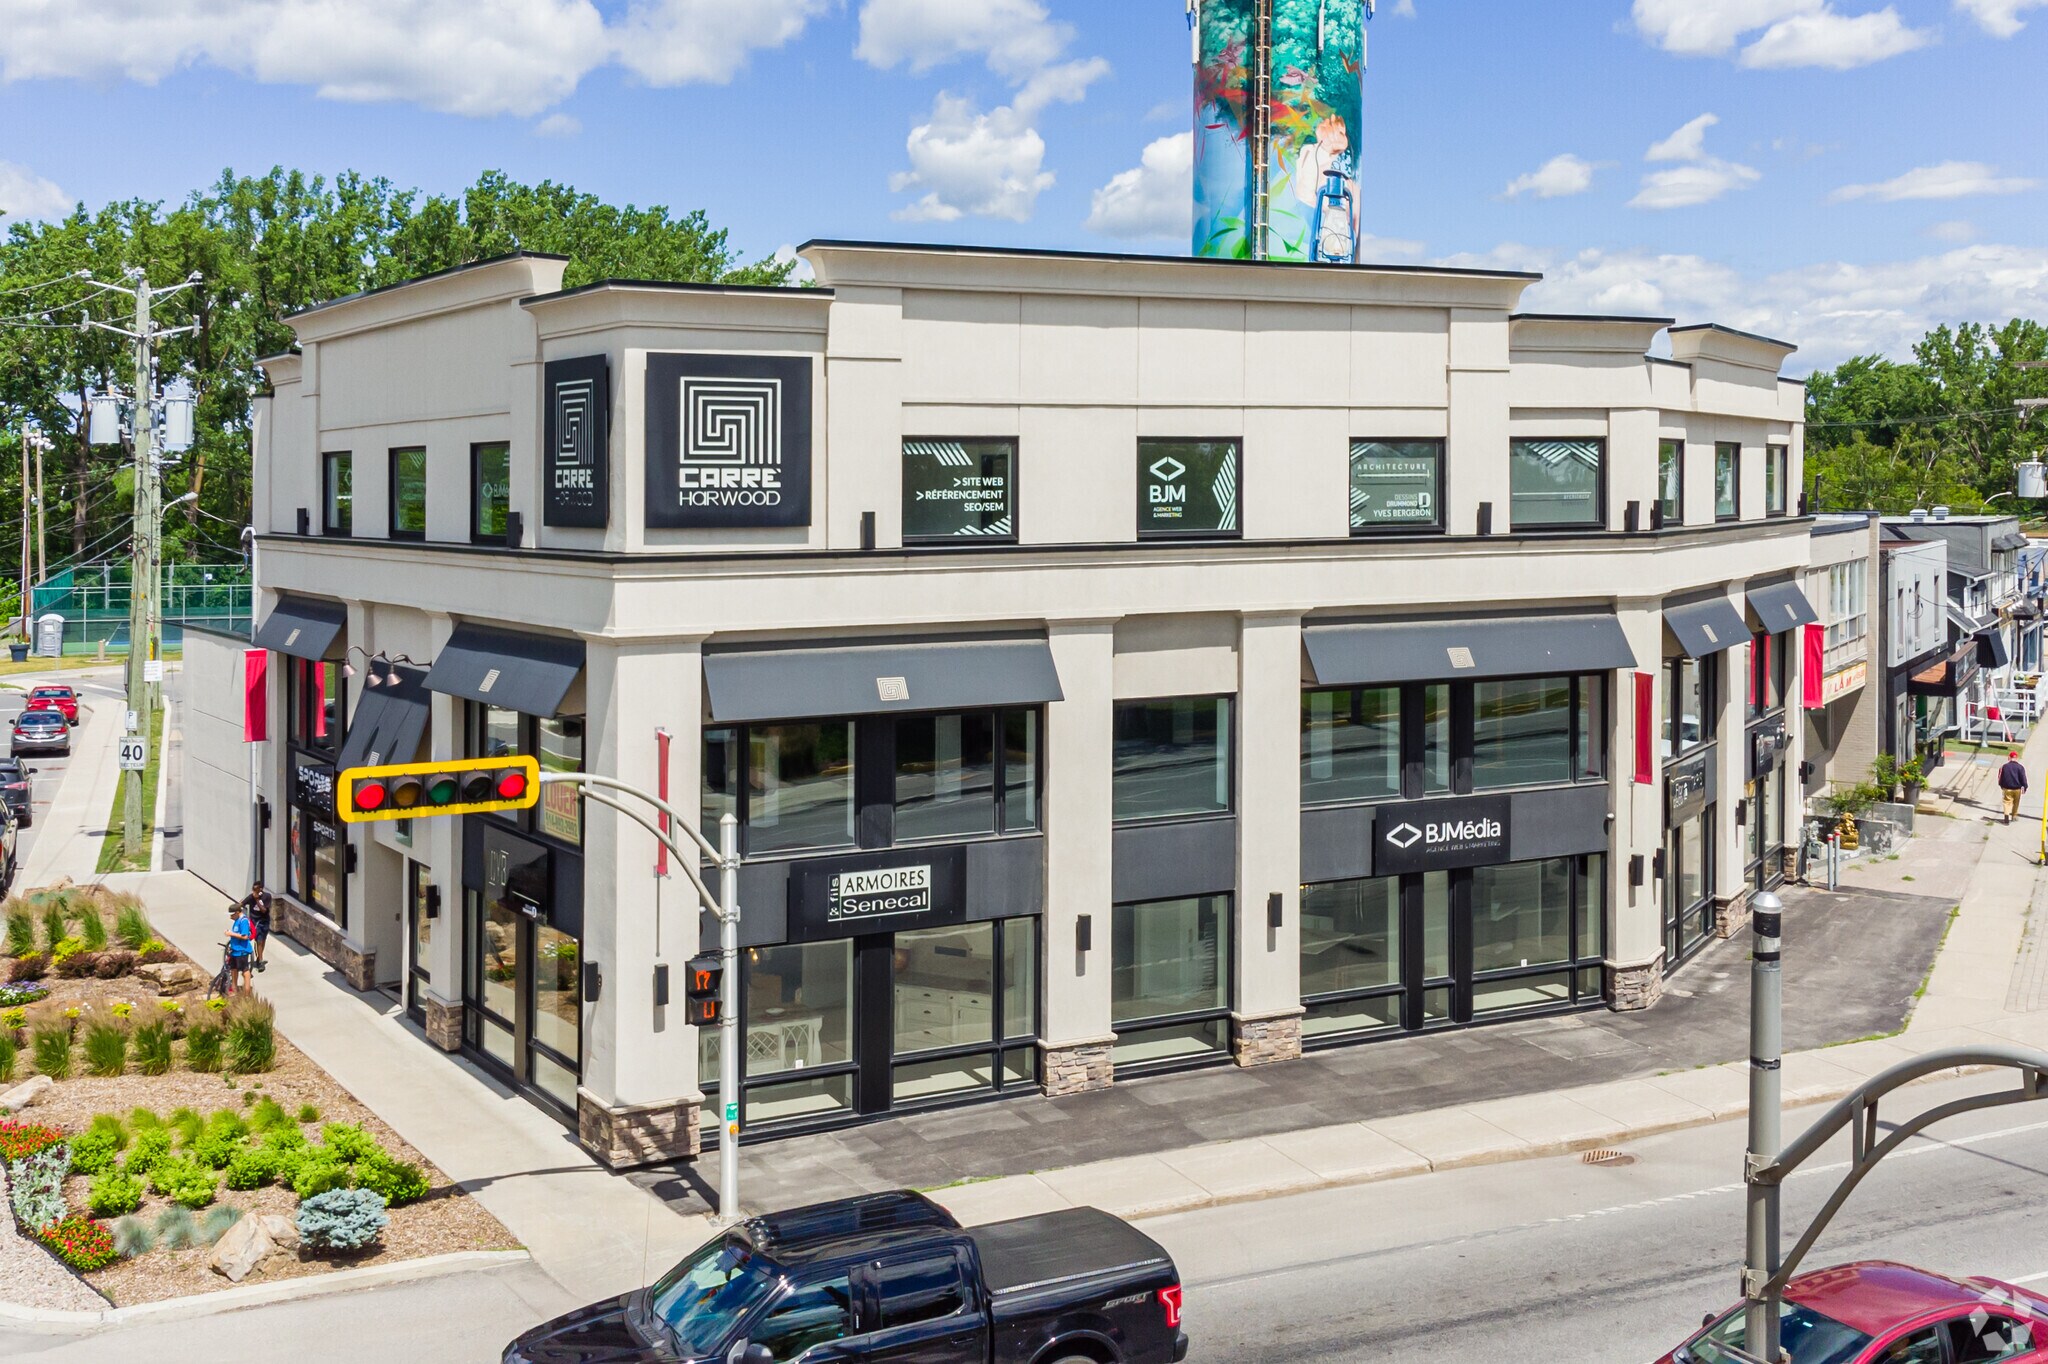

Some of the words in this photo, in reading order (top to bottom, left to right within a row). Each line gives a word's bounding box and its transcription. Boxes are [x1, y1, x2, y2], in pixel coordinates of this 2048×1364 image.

[1357, 463, 1427, 471] ARCHITECTURE
[962, 477, 981, 487] SITE
[982, 476, 1004, 487] WEB
[679, 491, 781, 506] HARWOOD
[1149, 485, 1186, 503] BJM
[964, 502, 1004, 513] SEO/SEM
[1373, 509, 1392, 518] YVES
[1392, 508, 1432, 517] BERGERON
[128, 711, 134, 719] P
[121, 744, 143, 761] 40
[1425, 817, 1501, 844] BJMédia
[829, 877, 840, 902] fils
[844, 869, 925, 894] ARMOIRES
[842, 891, 927, 914] Senecal
